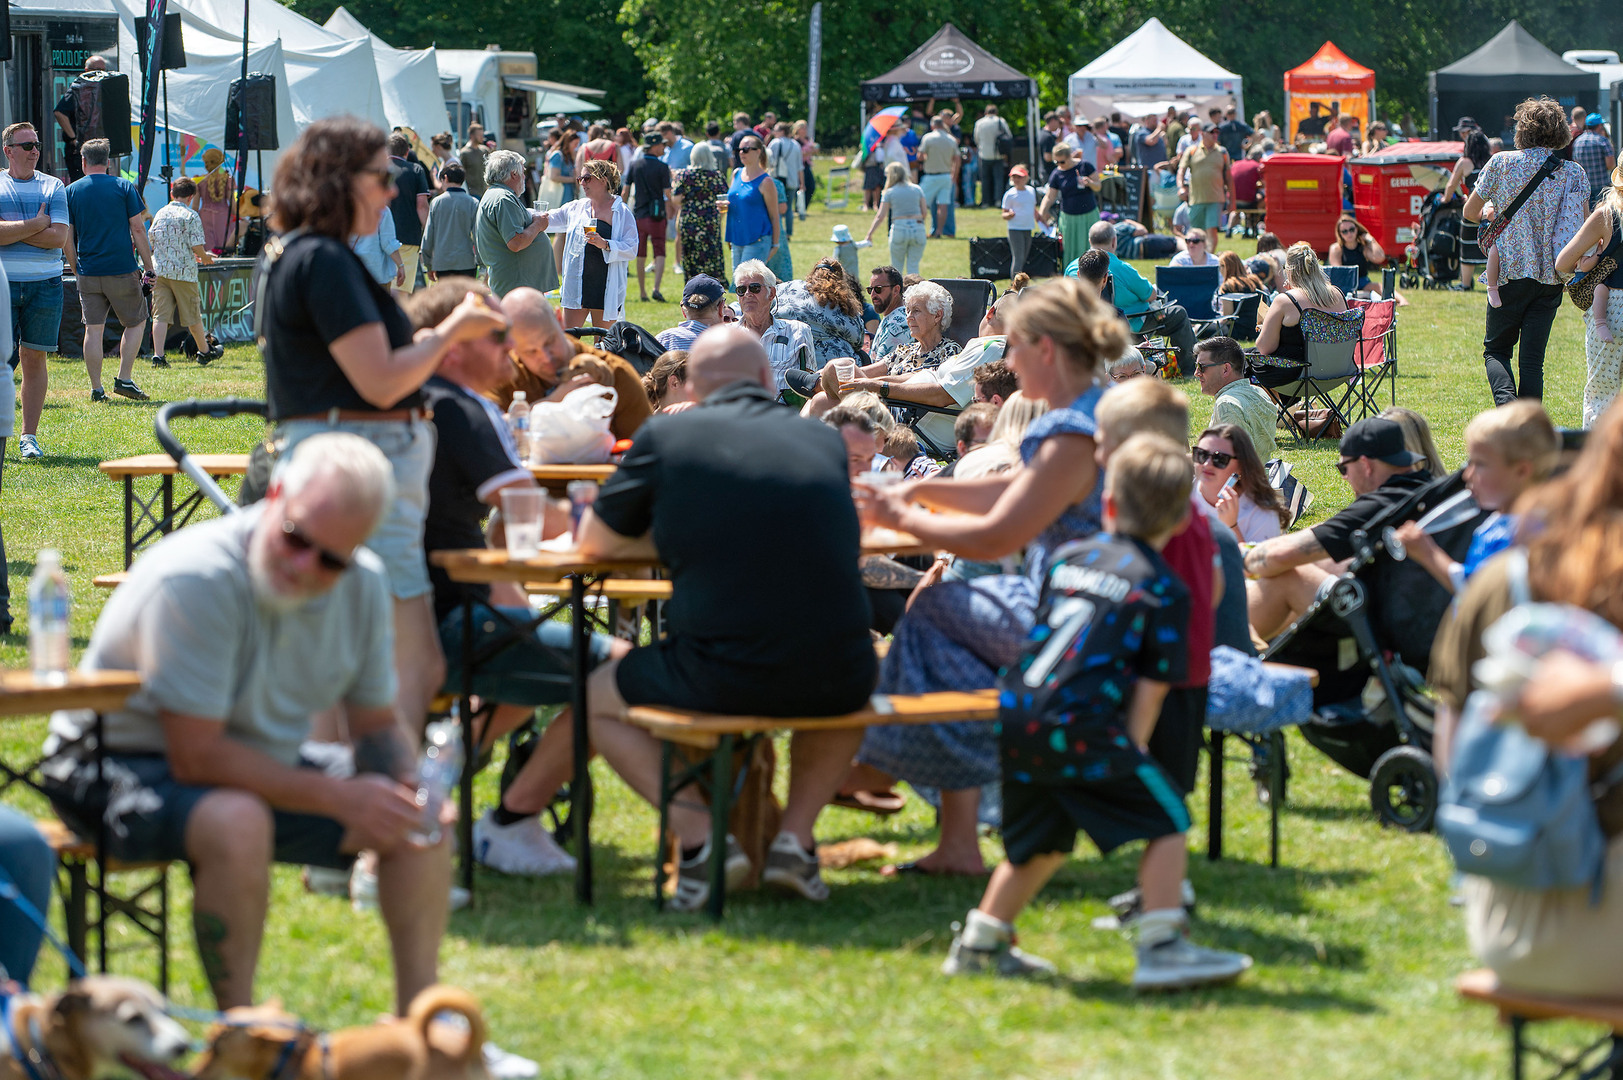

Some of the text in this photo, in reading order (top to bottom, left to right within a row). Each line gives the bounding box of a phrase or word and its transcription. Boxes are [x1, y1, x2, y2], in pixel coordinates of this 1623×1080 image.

[52, 49, 73, 66] PROUD
[74, 49, 83, 66] OF
[1390, 177, 1421, 187] GENERA
[1023, 596, 1096, 689] 7
